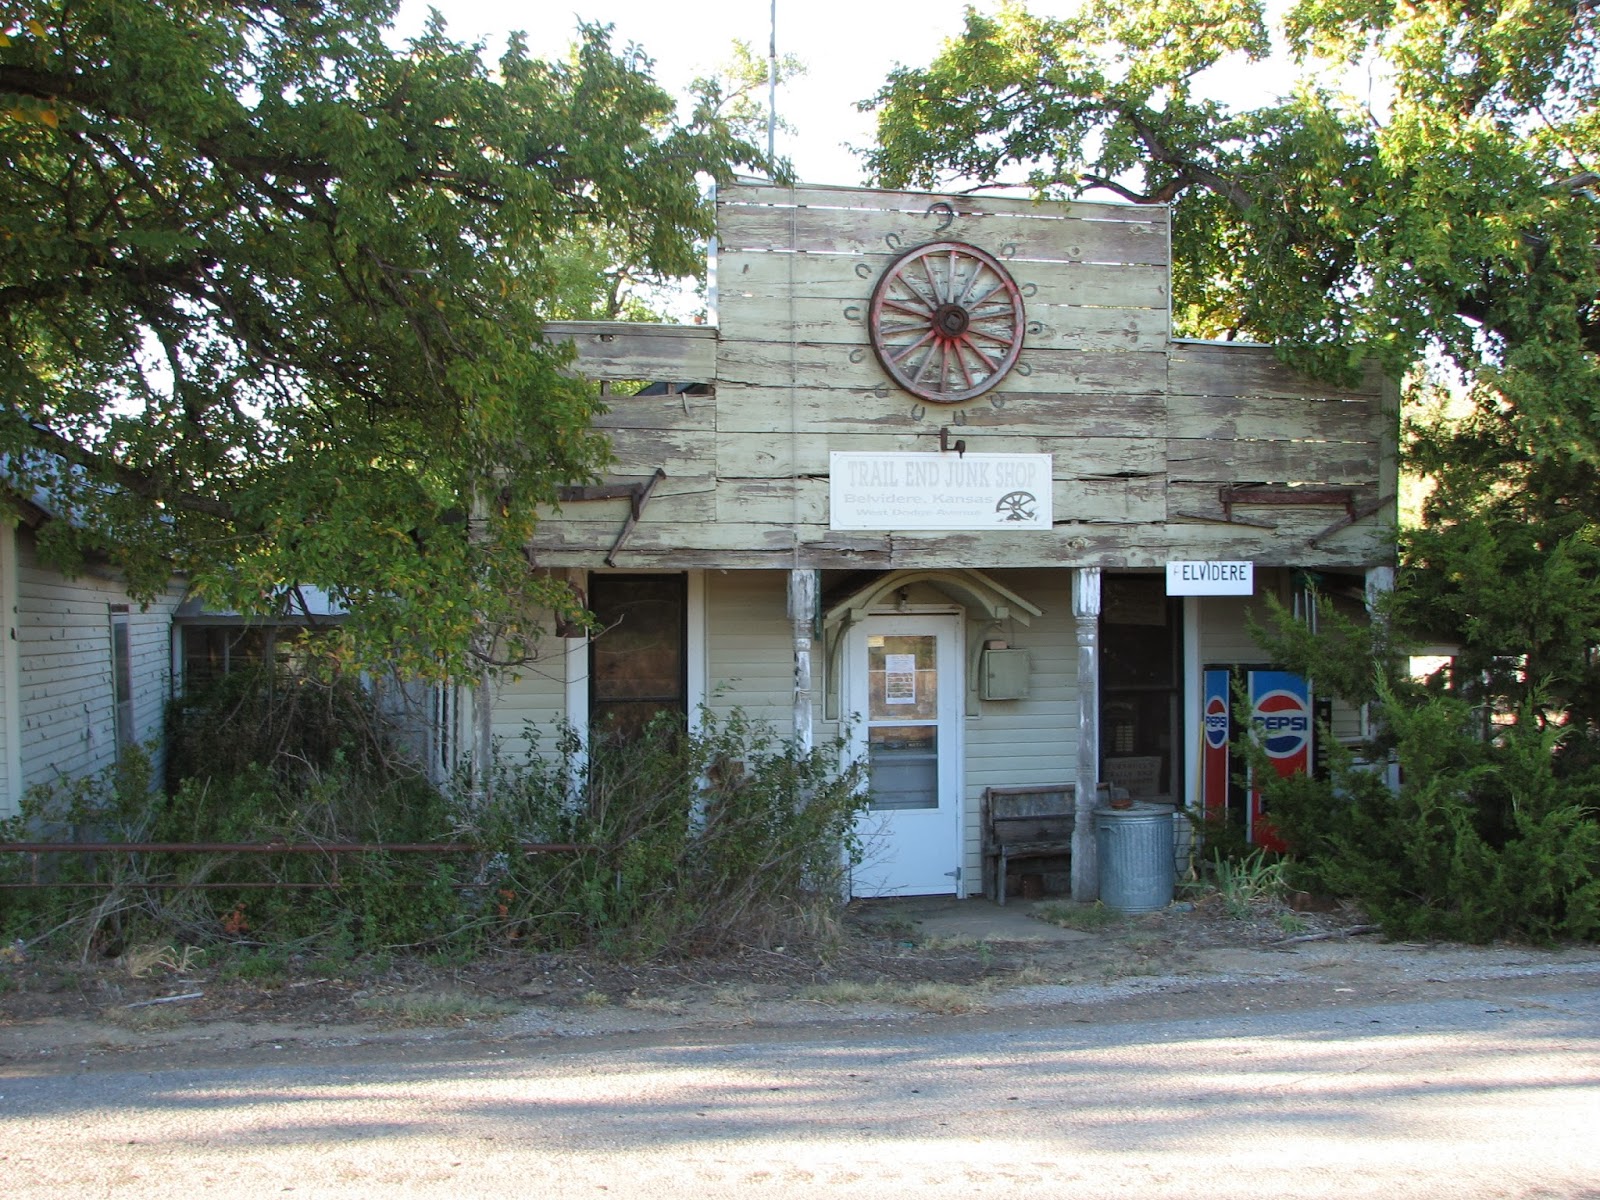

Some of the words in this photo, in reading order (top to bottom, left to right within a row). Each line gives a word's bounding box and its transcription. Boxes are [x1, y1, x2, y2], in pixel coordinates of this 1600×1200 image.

[848, 461, 898, 487] TRAIL
[905, 461, 940, 487] END
[944, 462, 991, 487] JUNK
[995, 462, 1036, 487] SHOP
[932, 493, 994, 504] Kansas
[1206, 716, 1227, 728] PEPSI
